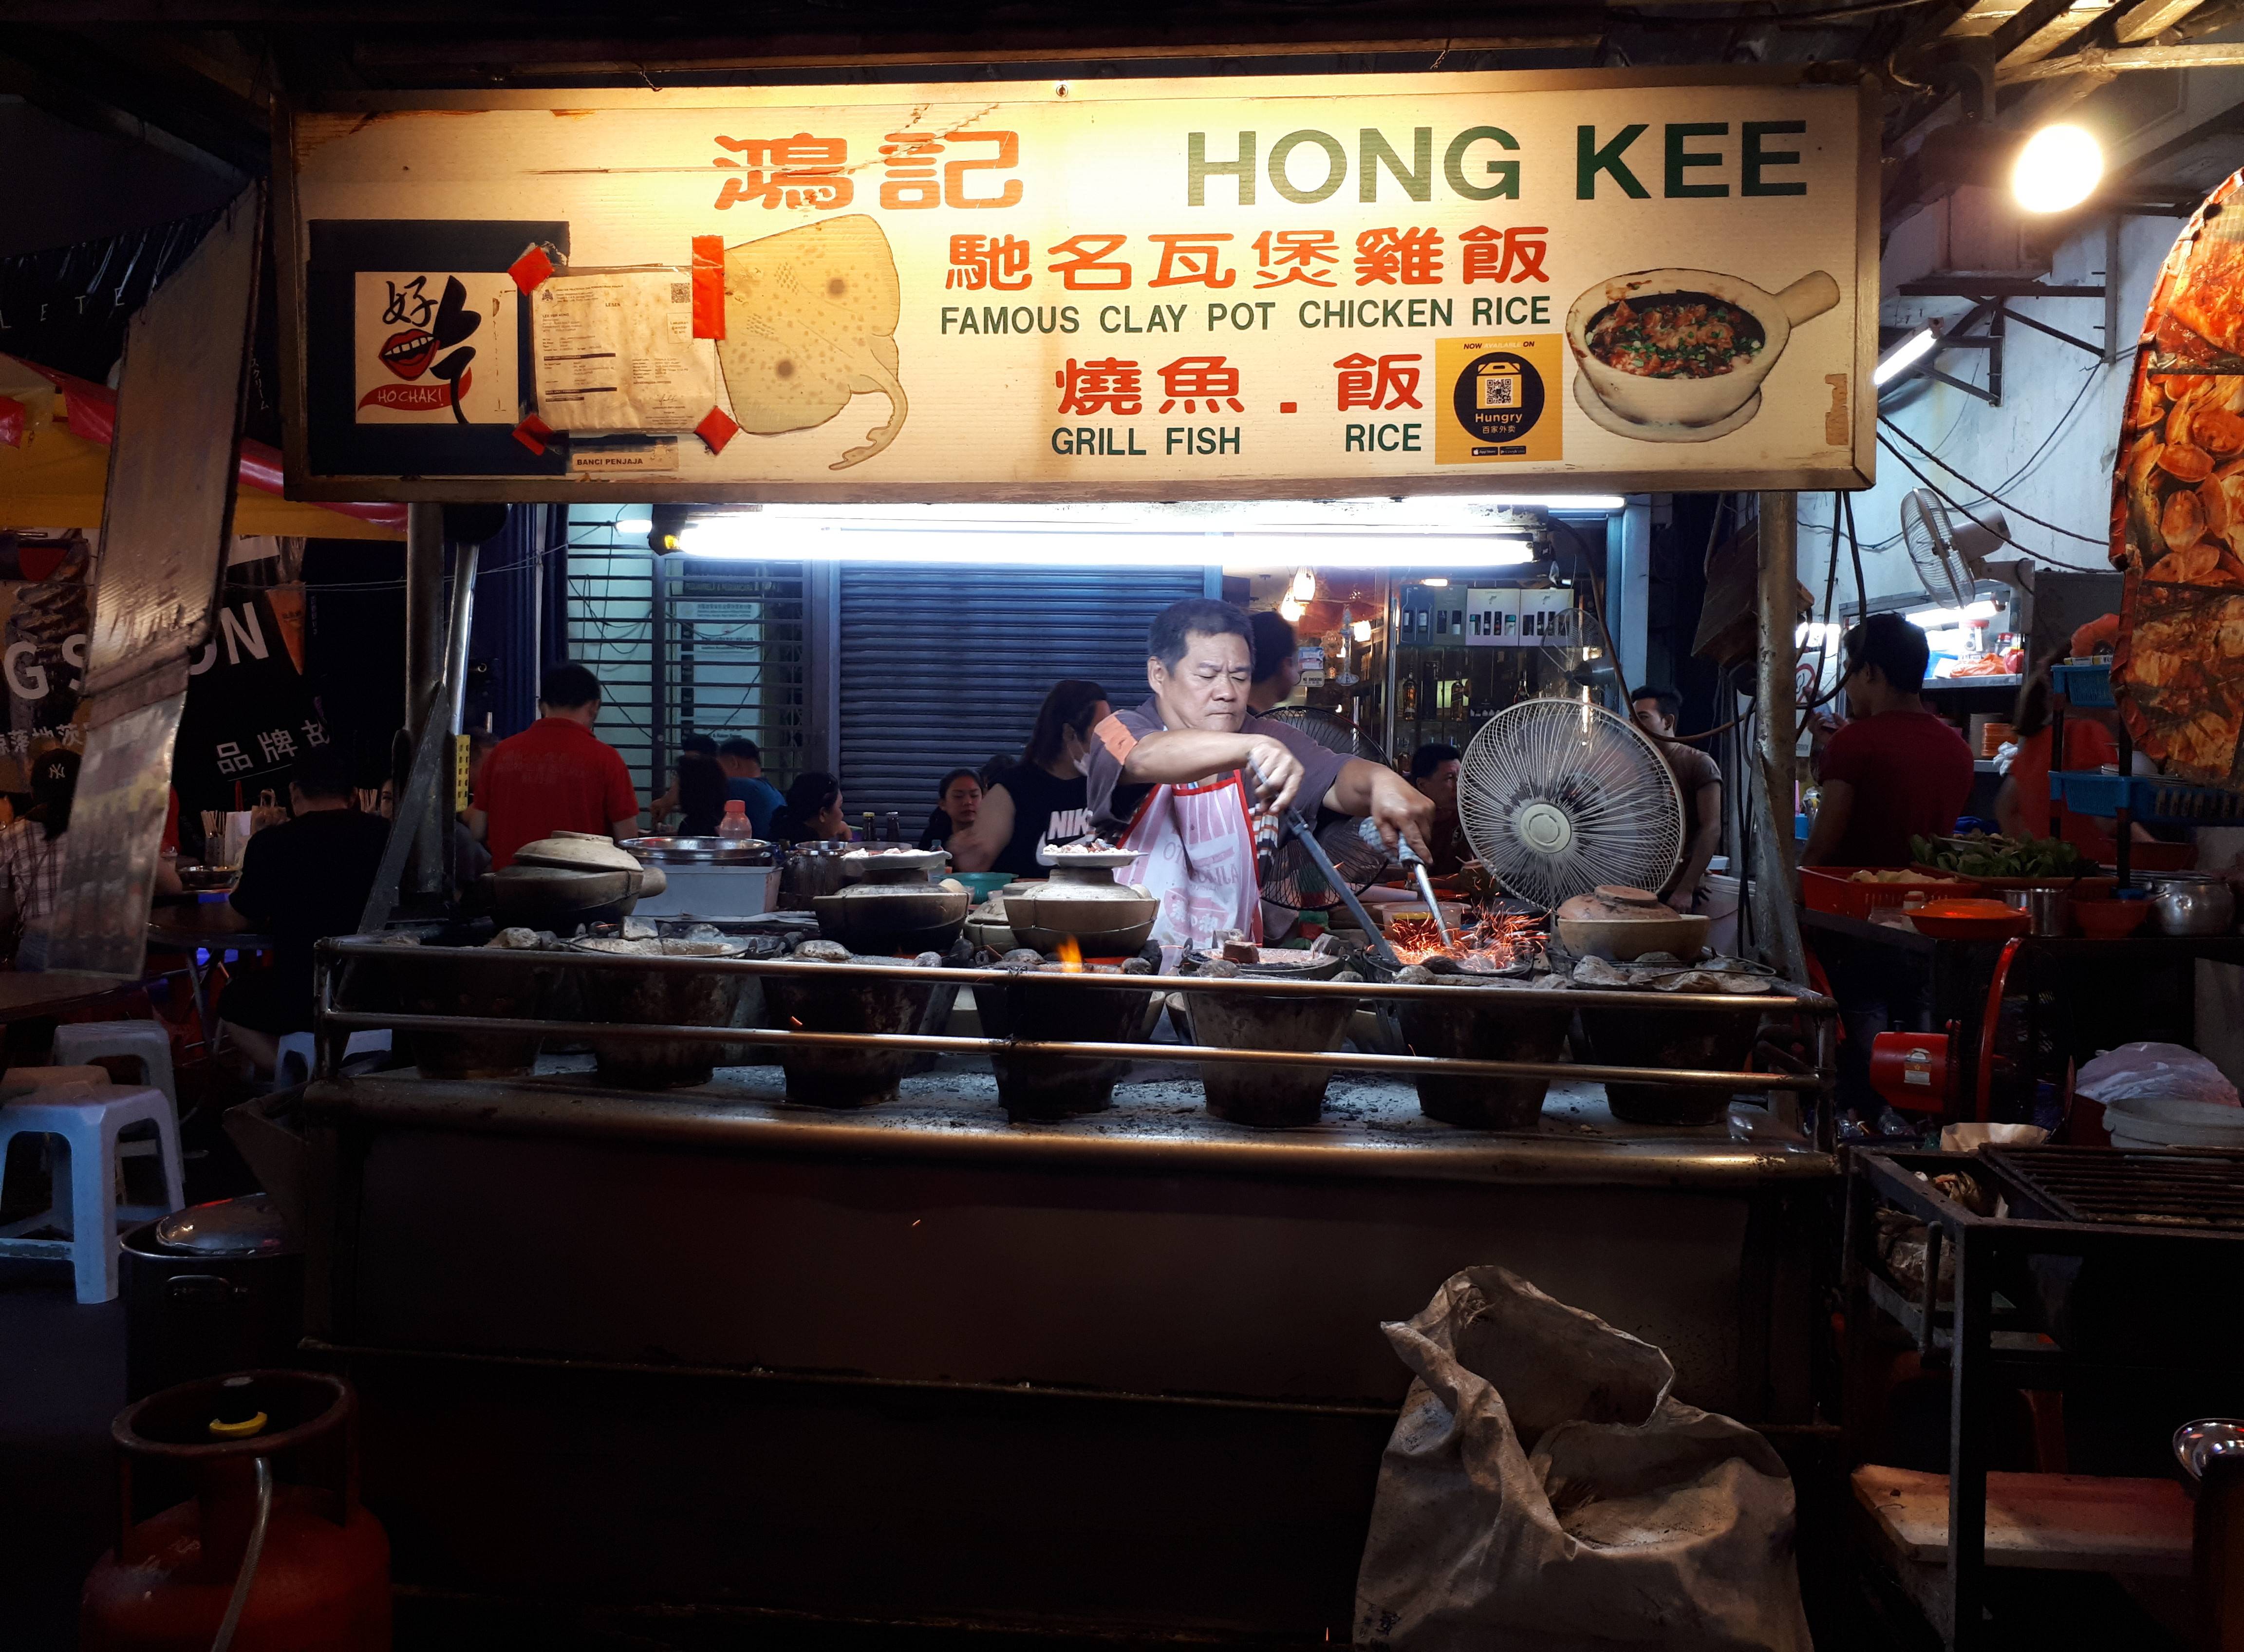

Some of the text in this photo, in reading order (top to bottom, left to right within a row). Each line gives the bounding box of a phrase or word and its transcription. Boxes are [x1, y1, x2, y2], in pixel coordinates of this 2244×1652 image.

[713, 131, 1024, 210] 鴻記
[1187, 120, 1808, 206] HONG KEE
[946, 225, 1550, 291] 馳名瓦煲雞飯
[941, 296, 1551, 335] FAMOUS CLAY POT CHICKEN RICE
[1051, 423, 1422, 456] GRILL FISH RICE
[1475, 413, 1523, 424] Hungry
